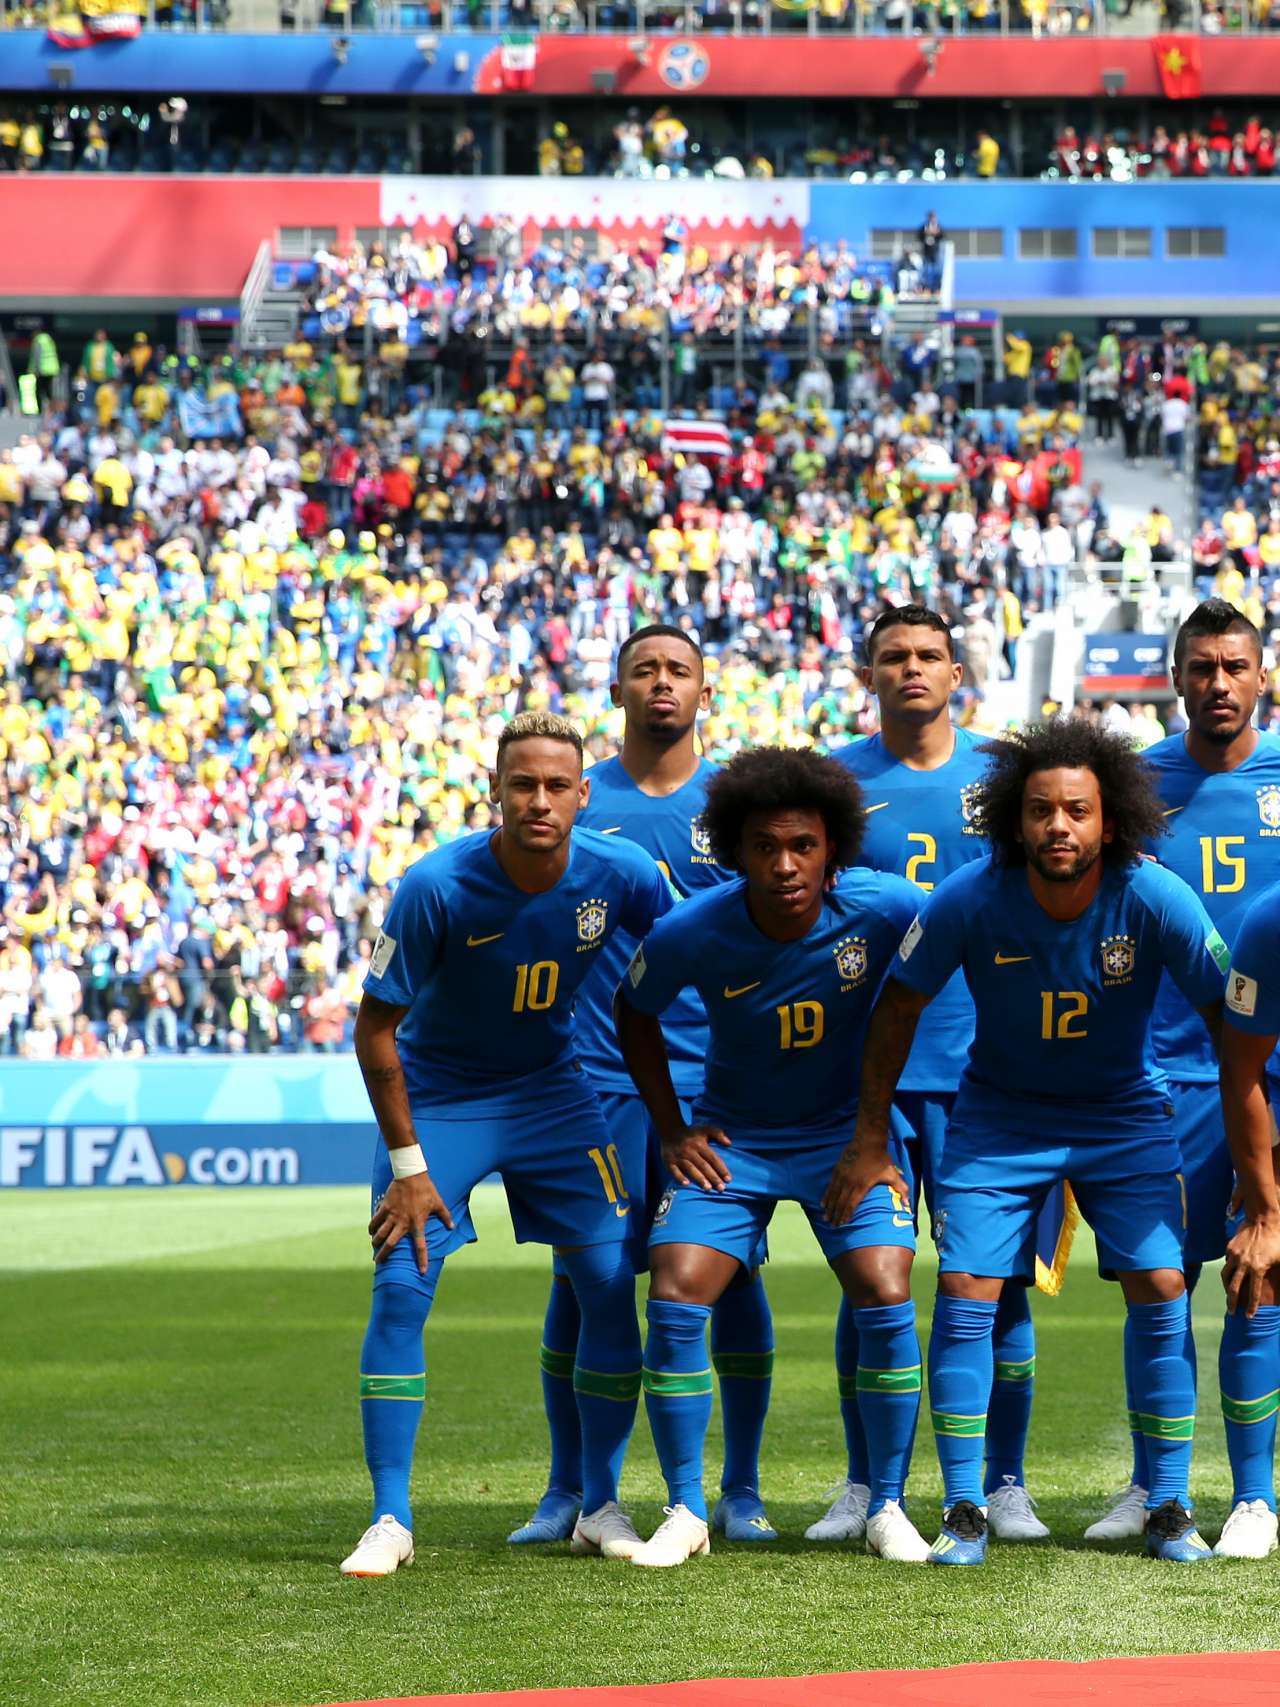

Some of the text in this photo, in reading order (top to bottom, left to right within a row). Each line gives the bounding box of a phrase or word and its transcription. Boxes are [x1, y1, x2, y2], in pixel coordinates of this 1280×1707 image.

[690, 855, 717, 865] BRASI
[906, 833, 936, 891] 2
[1200, 836, 1246, 893] 15
[512, 960, 559, 1012] 10
[777, 1000, 824, 1048] 19
[1041, 991, 1088, 1040] 12
[0, 1127, 299, 1185] FIFA.com
